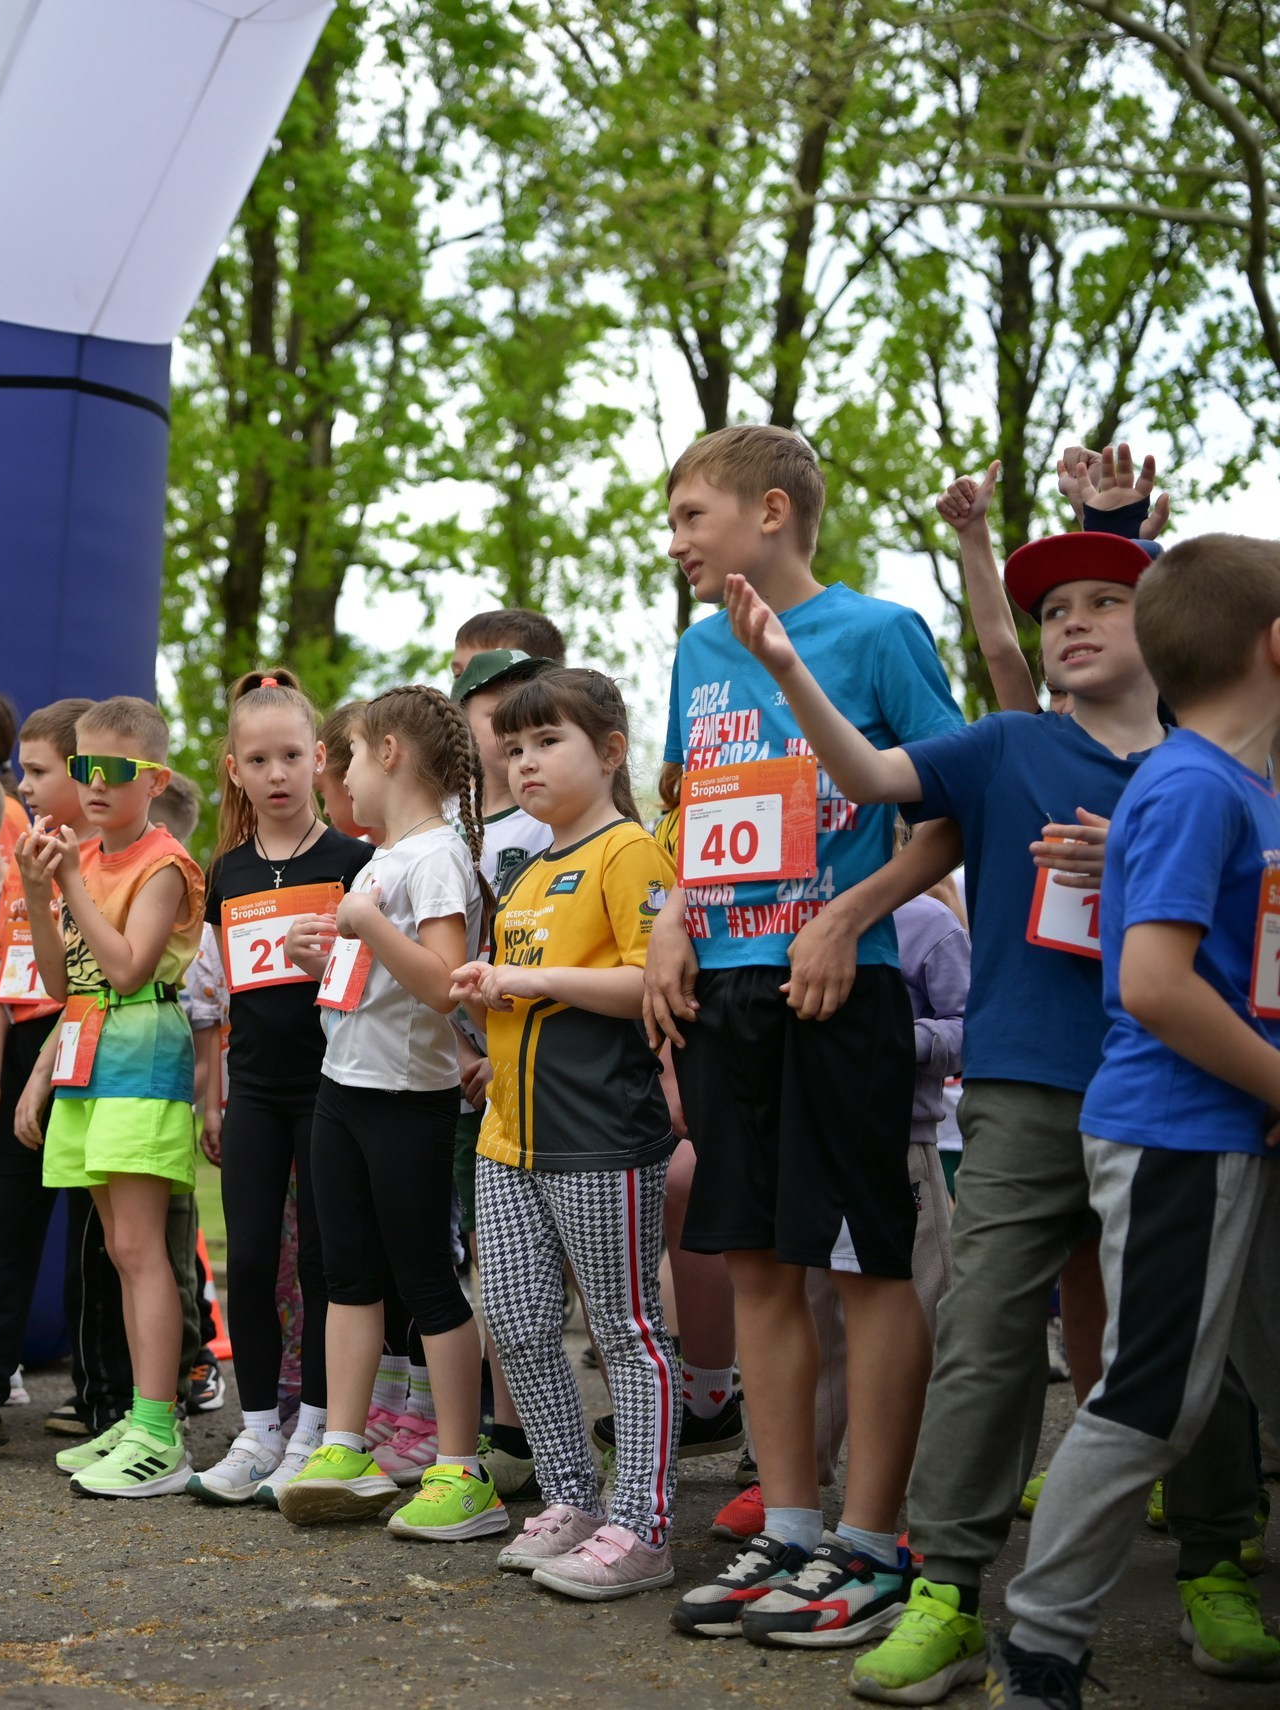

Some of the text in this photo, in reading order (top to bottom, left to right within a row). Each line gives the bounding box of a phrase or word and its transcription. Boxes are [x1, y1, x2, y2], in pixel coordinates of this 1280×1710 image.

[686, 680, 730, 717] 2024
[688, 709, 760, 747] #МЕЧТА
[700, 820, 759, 866] 40
[523, 917, 537, 926] ЕГА
[249, 935, 294, 974] 21
